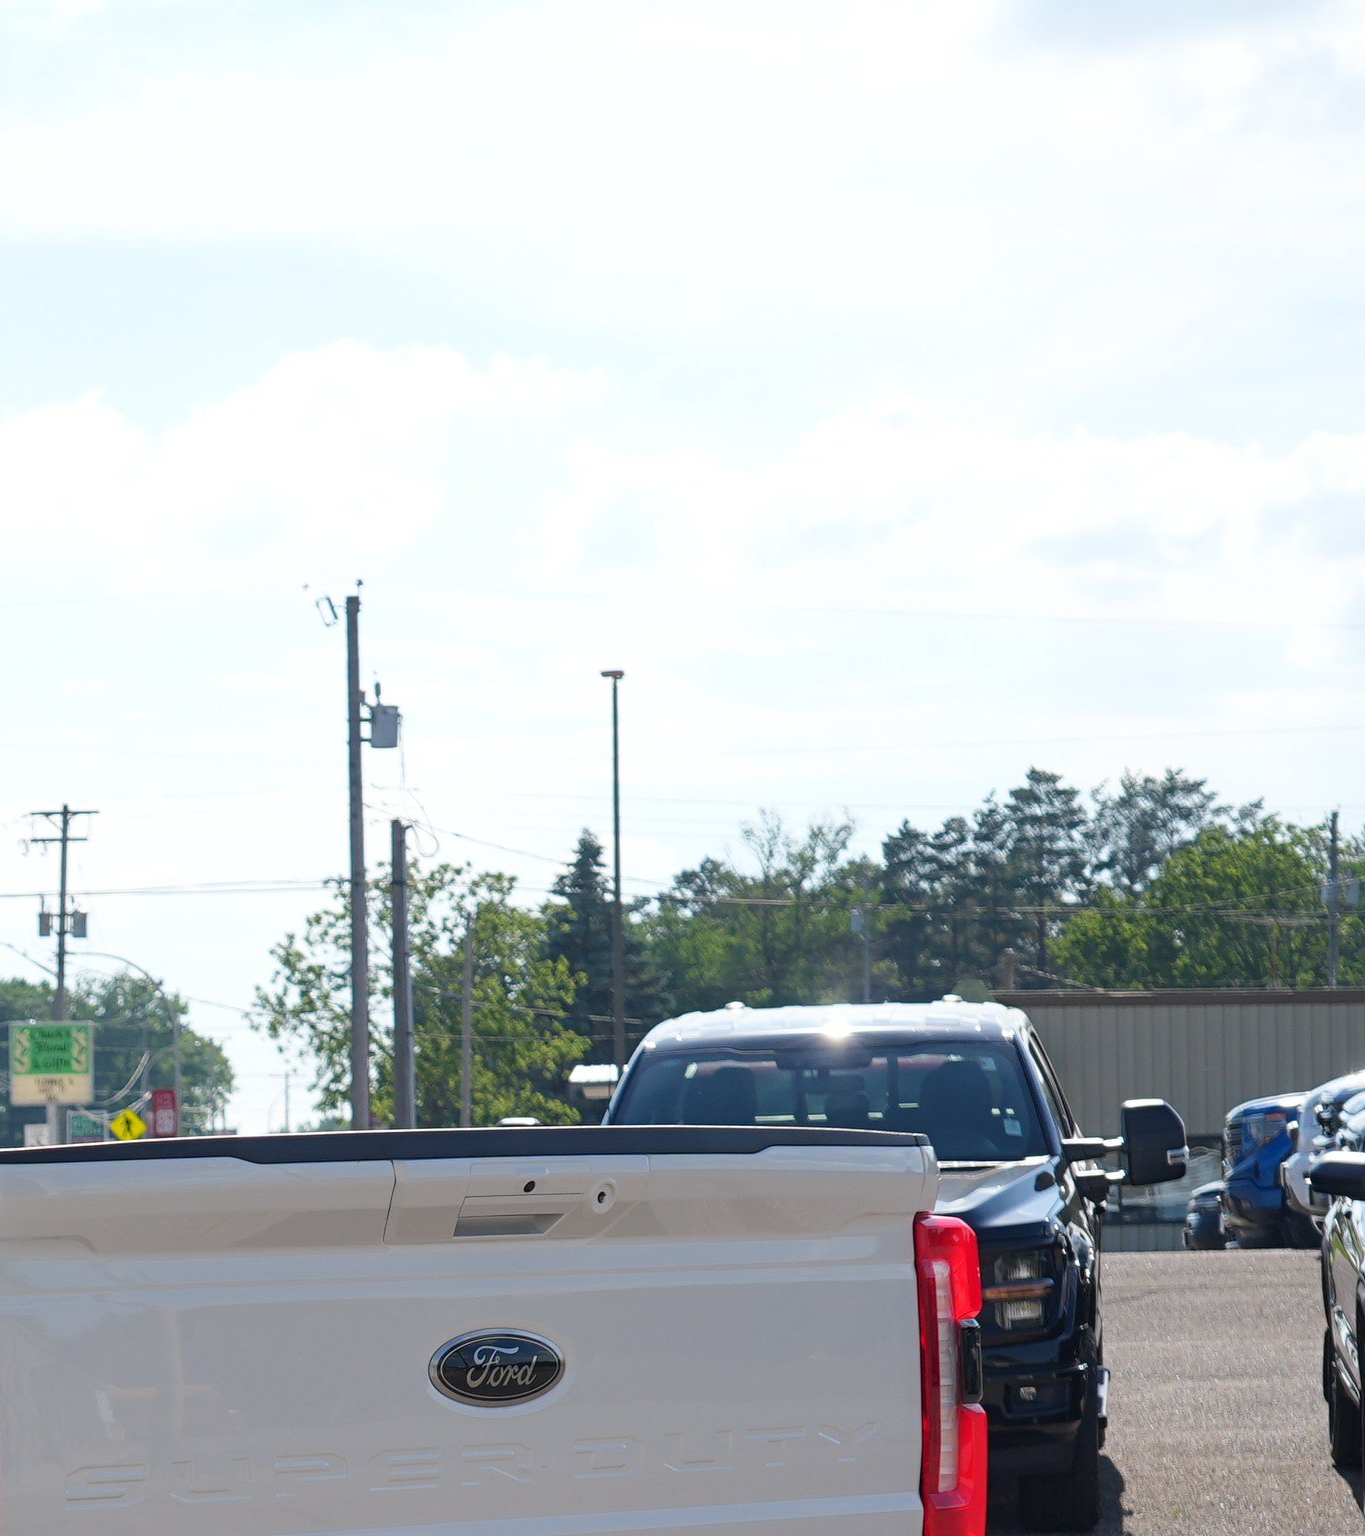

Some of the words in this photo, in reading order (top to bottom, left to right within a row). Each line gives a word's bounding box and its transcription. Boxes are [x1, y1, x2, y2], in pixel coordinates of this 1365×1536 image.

[467, 1345, 537, 1388] Ford
[65, 1442, 533, 1512] SUPER
[574, 1420, 879, 1479] DUTY
